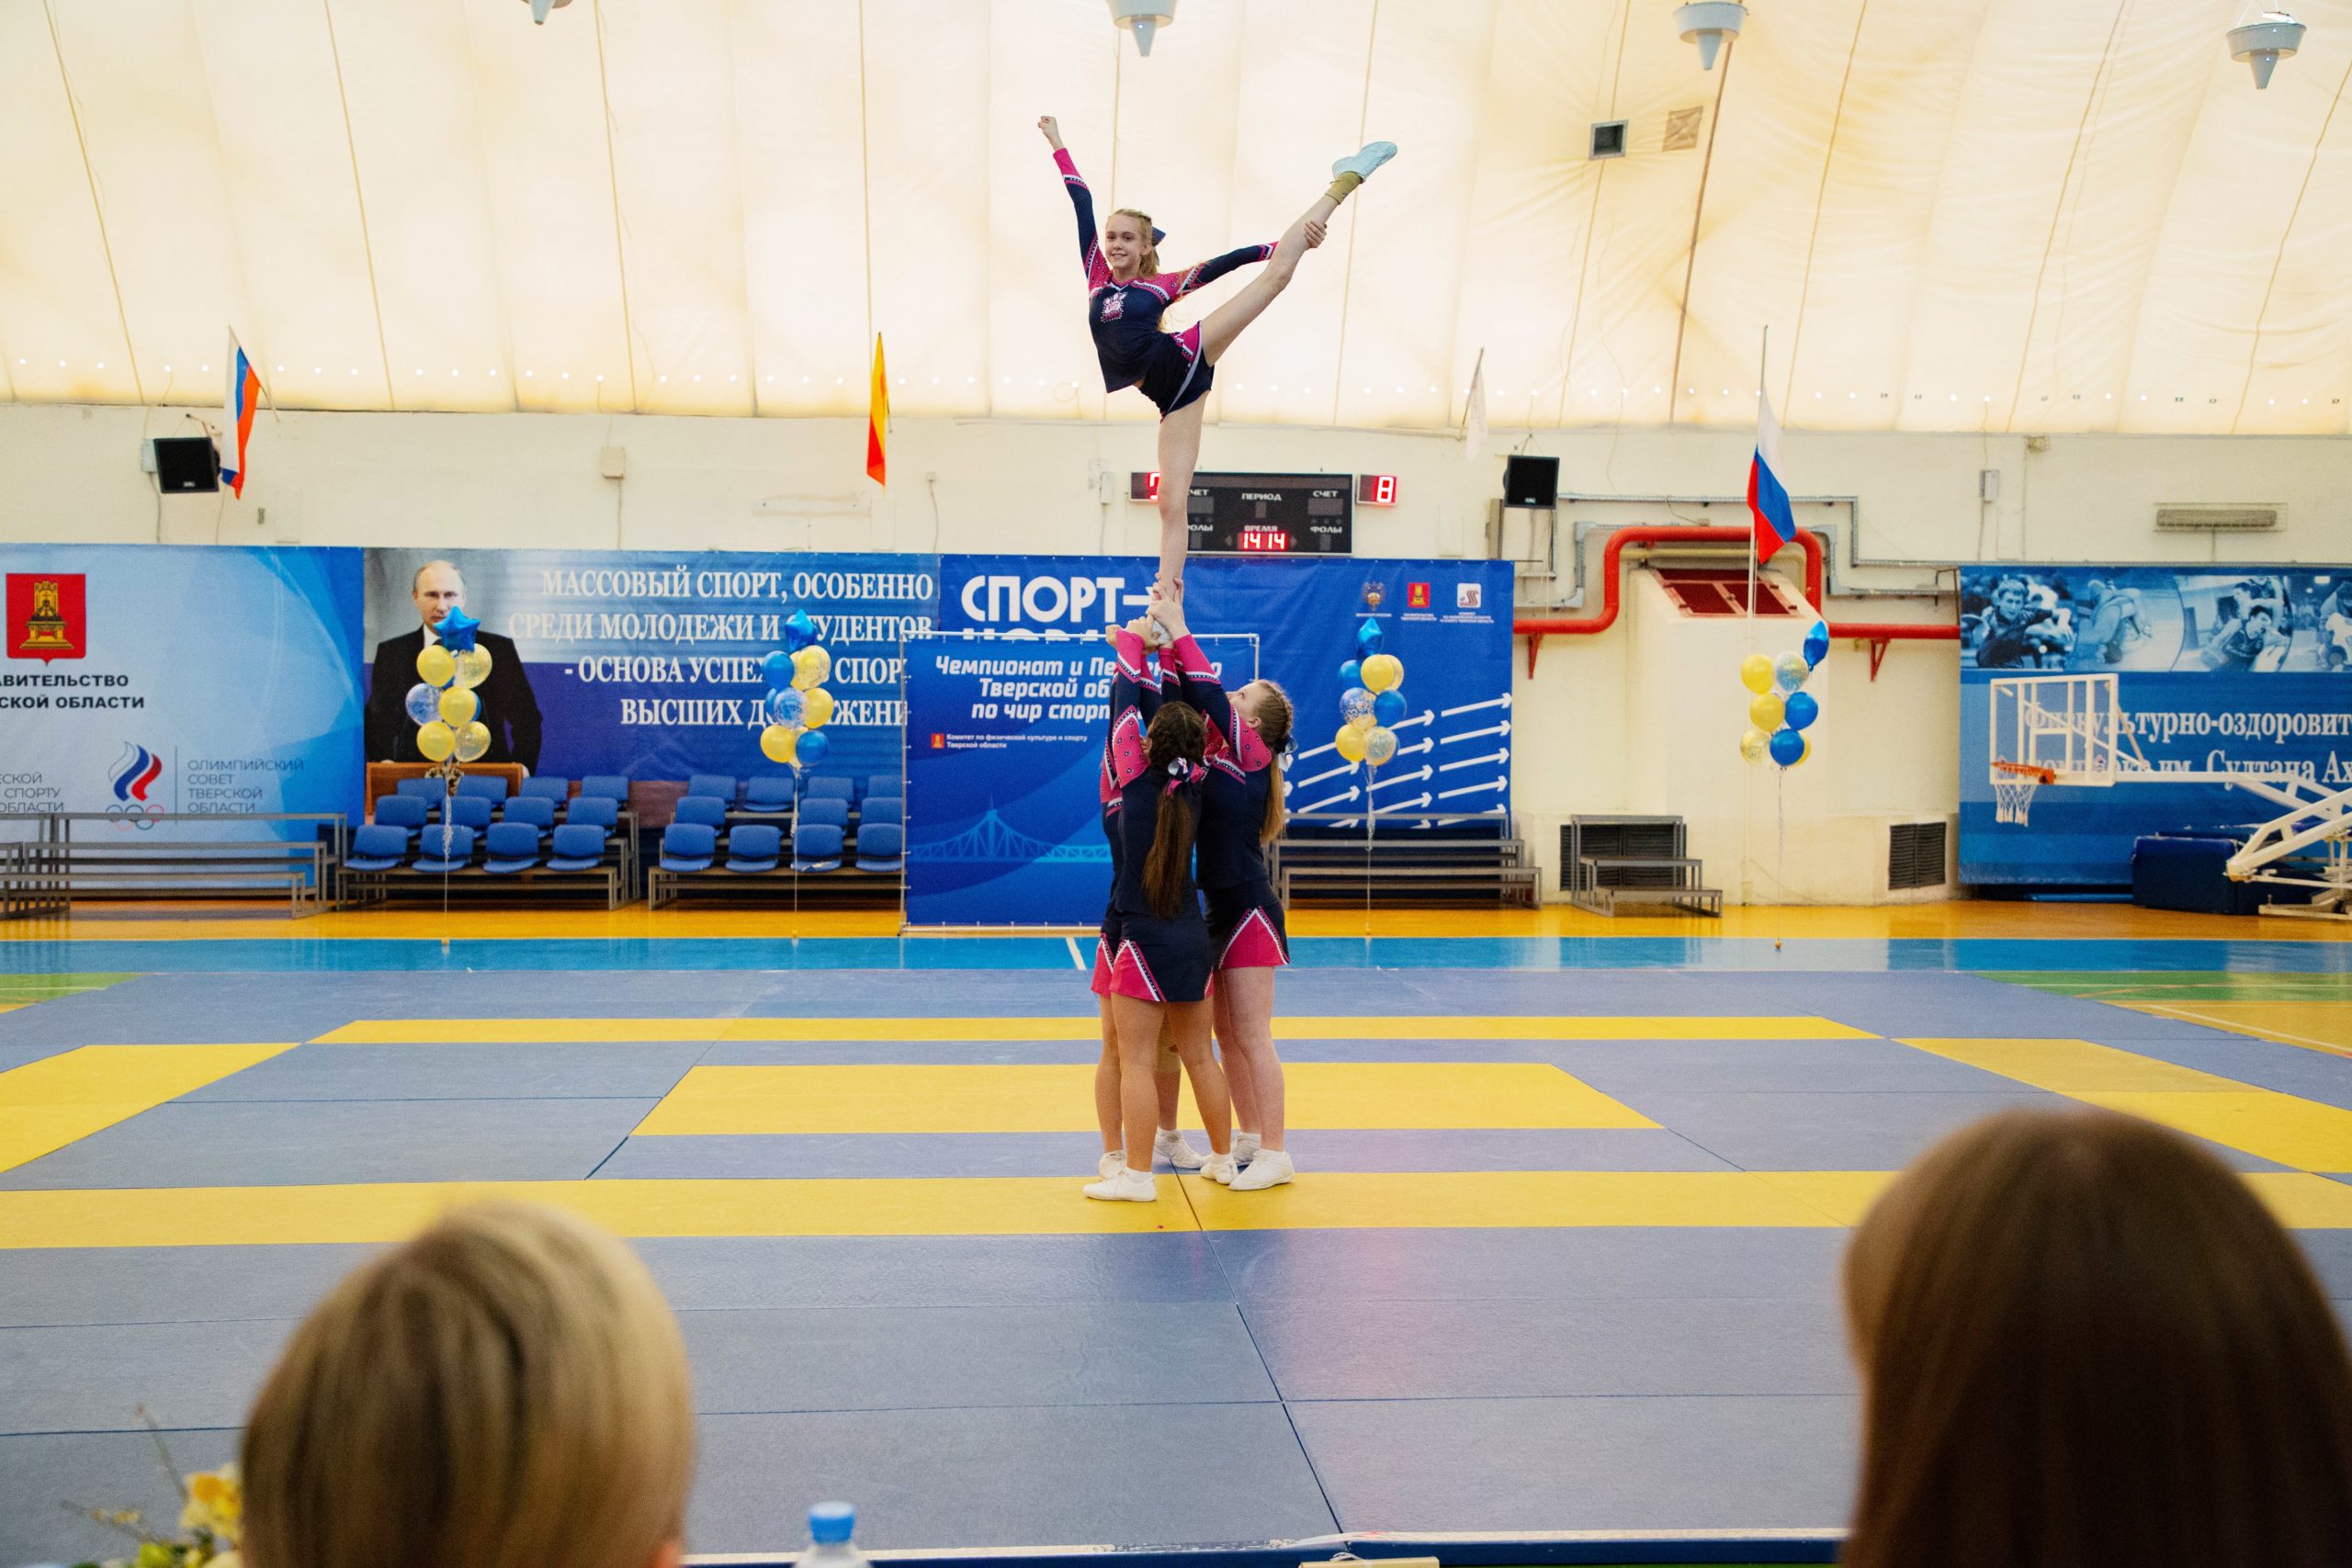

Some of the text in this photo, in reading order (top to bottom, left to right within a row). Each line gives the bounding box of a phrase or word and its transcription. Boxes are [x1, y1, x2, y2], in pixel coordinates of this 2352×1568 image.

[1376, 475, 1394, 503] 8
[1241, 493, 1282, 502] ПЕРИОД
[1310, 525, 1342, 534] ФОЛЫ
[541, 565, 933, 604] МАССОВЫЙ СПОРТ, ОСОБЕННО
[960, 575, 1125, 623] СПОРТ
[508, 613, 594, 645] СРЕДИ
[599, 614, 755, 646] МОЛОДЕЖИ
[761, 615, 780, 640] И
[578, 656, 684, 683] ОСНОВА
[834, 658, 908, 684] СПОР
[935, 655, 1063, 676] Чемпионат
[1069, 660, 1083, 676] и
[0, 674, 129, 687] ВИТЕЛЬСТВО
[979, 678, 1078, 701] Тверской
[55, 696, 145, 709] ОБЛАСТИ
[621, 699, 743, 726] ВЫСШИХ
[972, 704, 998, 719] по
[1003, 705, 1043, 723] чир
[187, 758, 304, 771] ОЛИМПИЙСКИЙ
[187, 773, 233, 784] СОВЕТ
[5, 787, 61, 799] СПОРТУ
[188, 786, 263, 799] ТВЕРСКОЙ
[187, 802, 255, 813] ОБЛАСТИ
